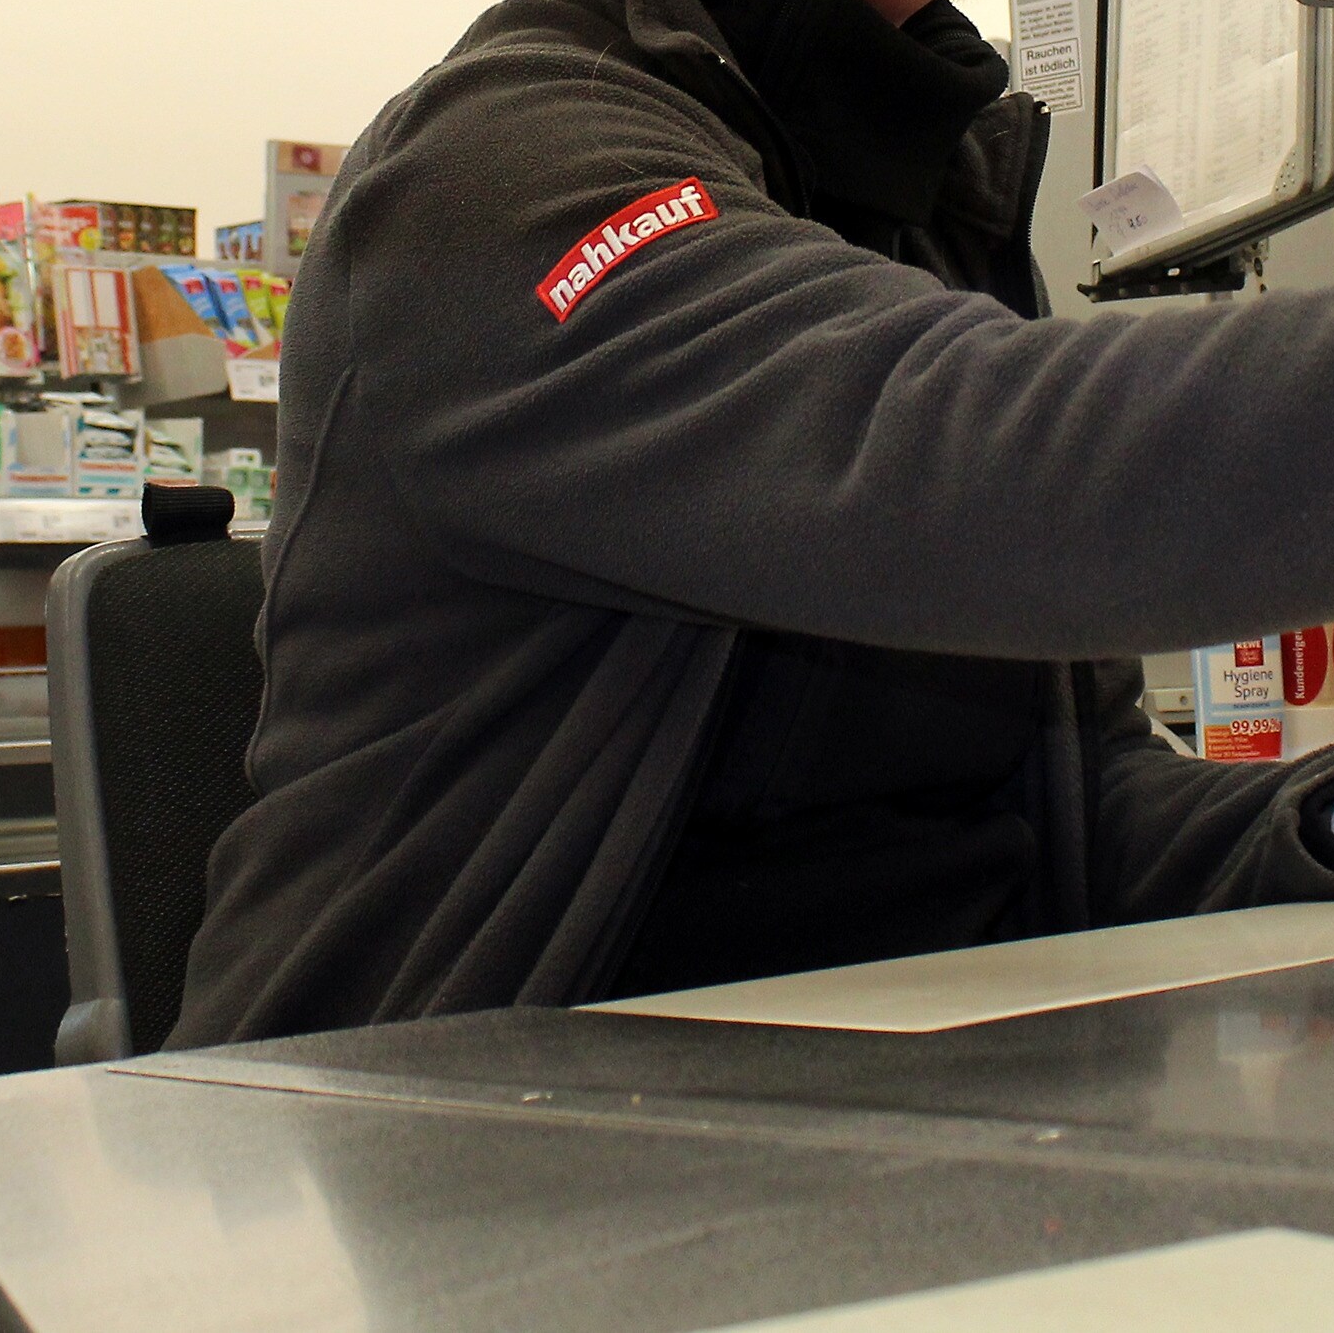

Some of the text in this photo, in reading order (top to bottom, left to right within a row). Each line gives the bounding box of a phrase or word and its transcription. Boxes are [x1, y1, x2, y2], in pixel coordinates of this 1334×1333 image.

[1027, 44, 1072, 62] Rauchen
[1025, 57, 1076, 76] ist tödlich
[548, 185, 705, 313] nahkauf
[1224, 669, 1274, 685] Hygiene
[1234, 685, 1269, 700] Spray
